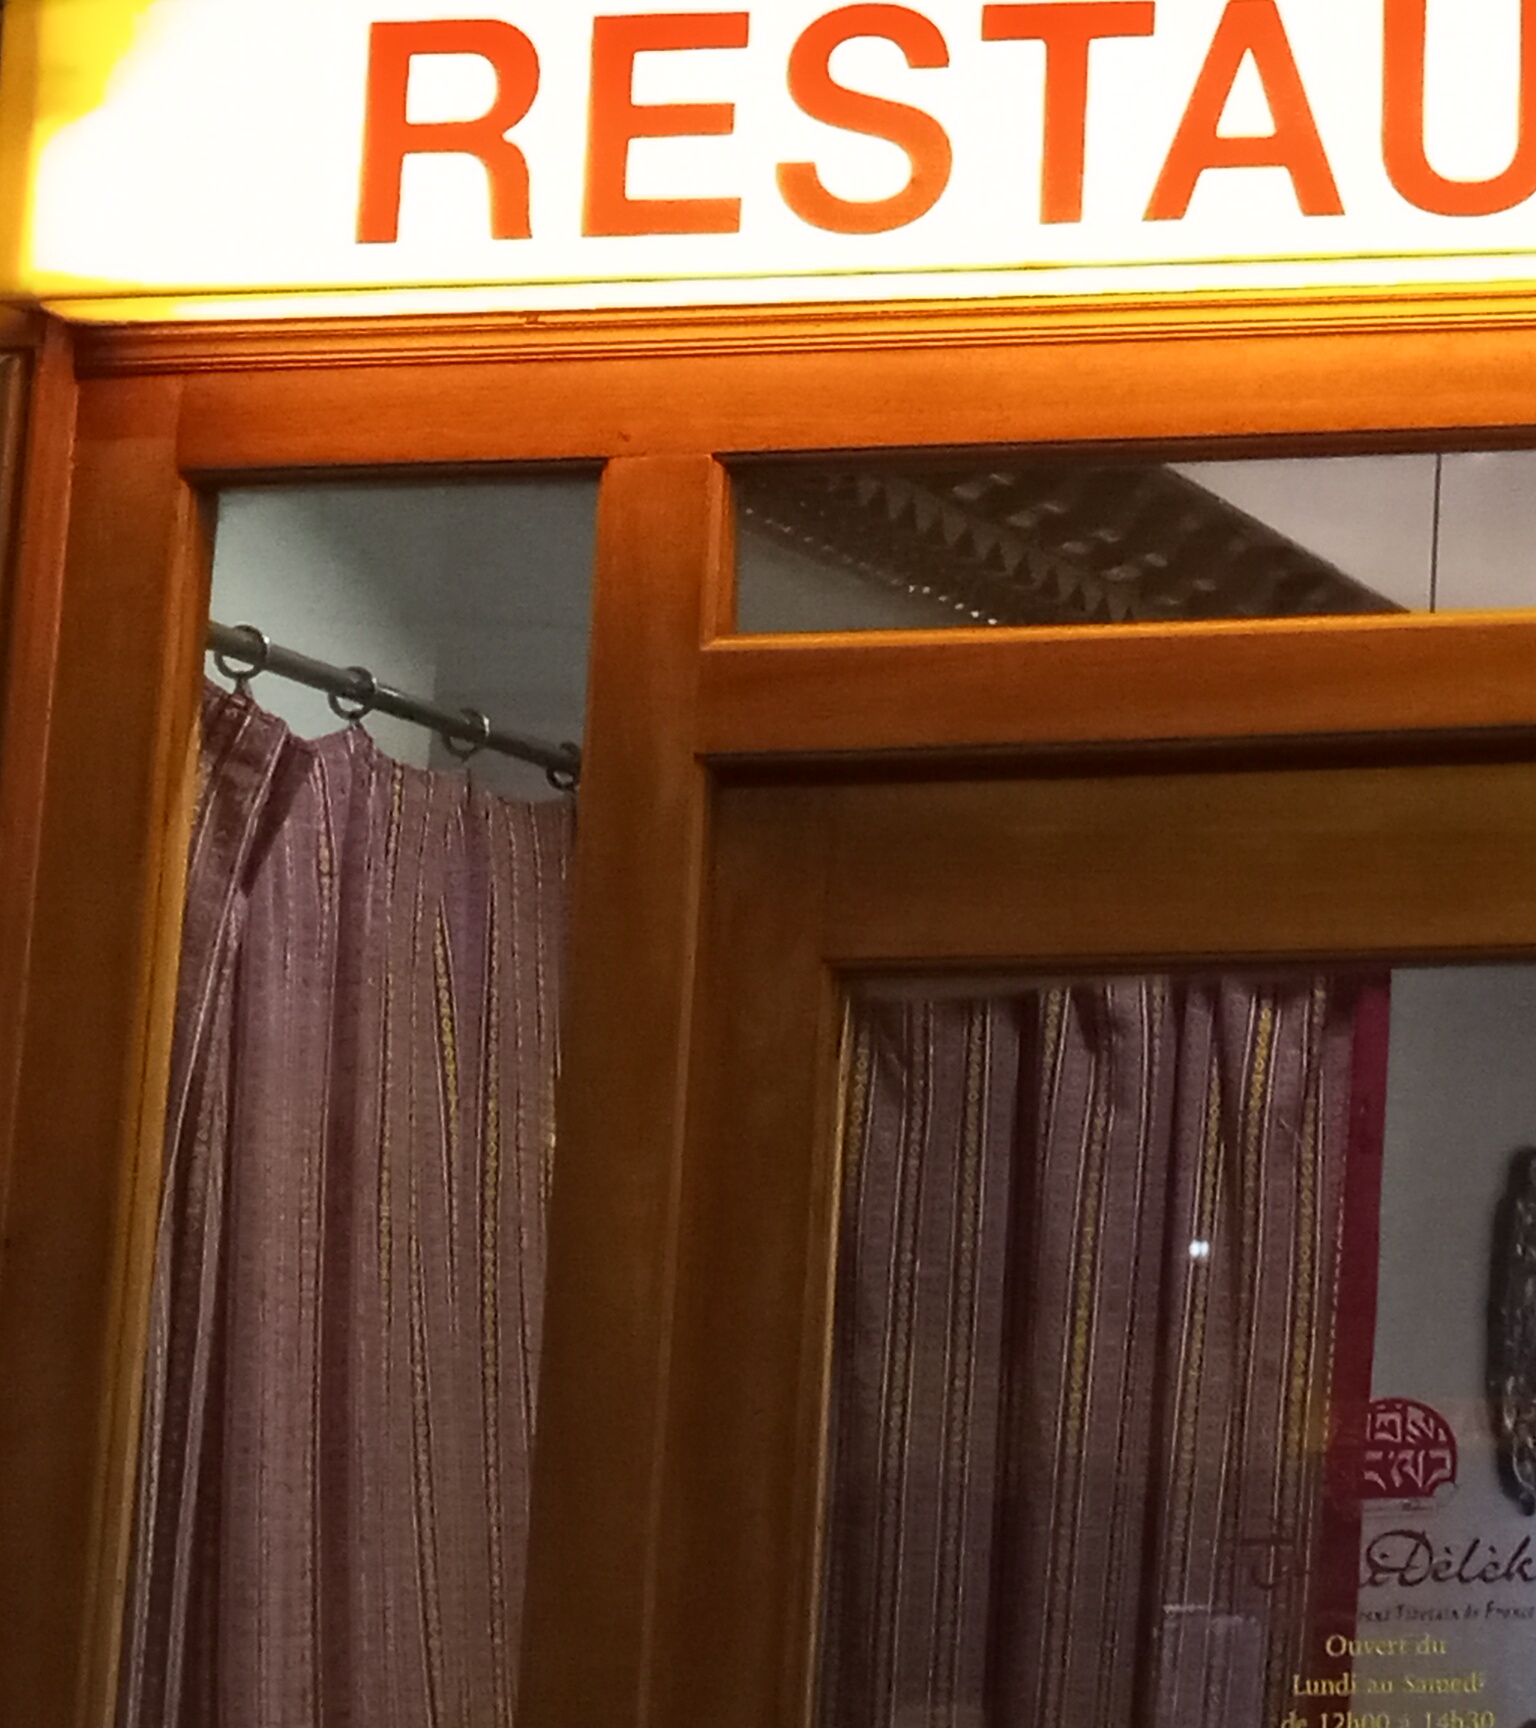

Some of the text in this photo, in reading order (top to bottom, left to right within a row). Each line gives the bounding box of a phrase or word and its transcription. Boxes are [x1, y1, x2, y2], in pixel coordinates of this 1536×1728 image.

[1325, 1633, 1447, 1658] Ouvert du
[1292, 1672, 1356, 1696] Lundi
